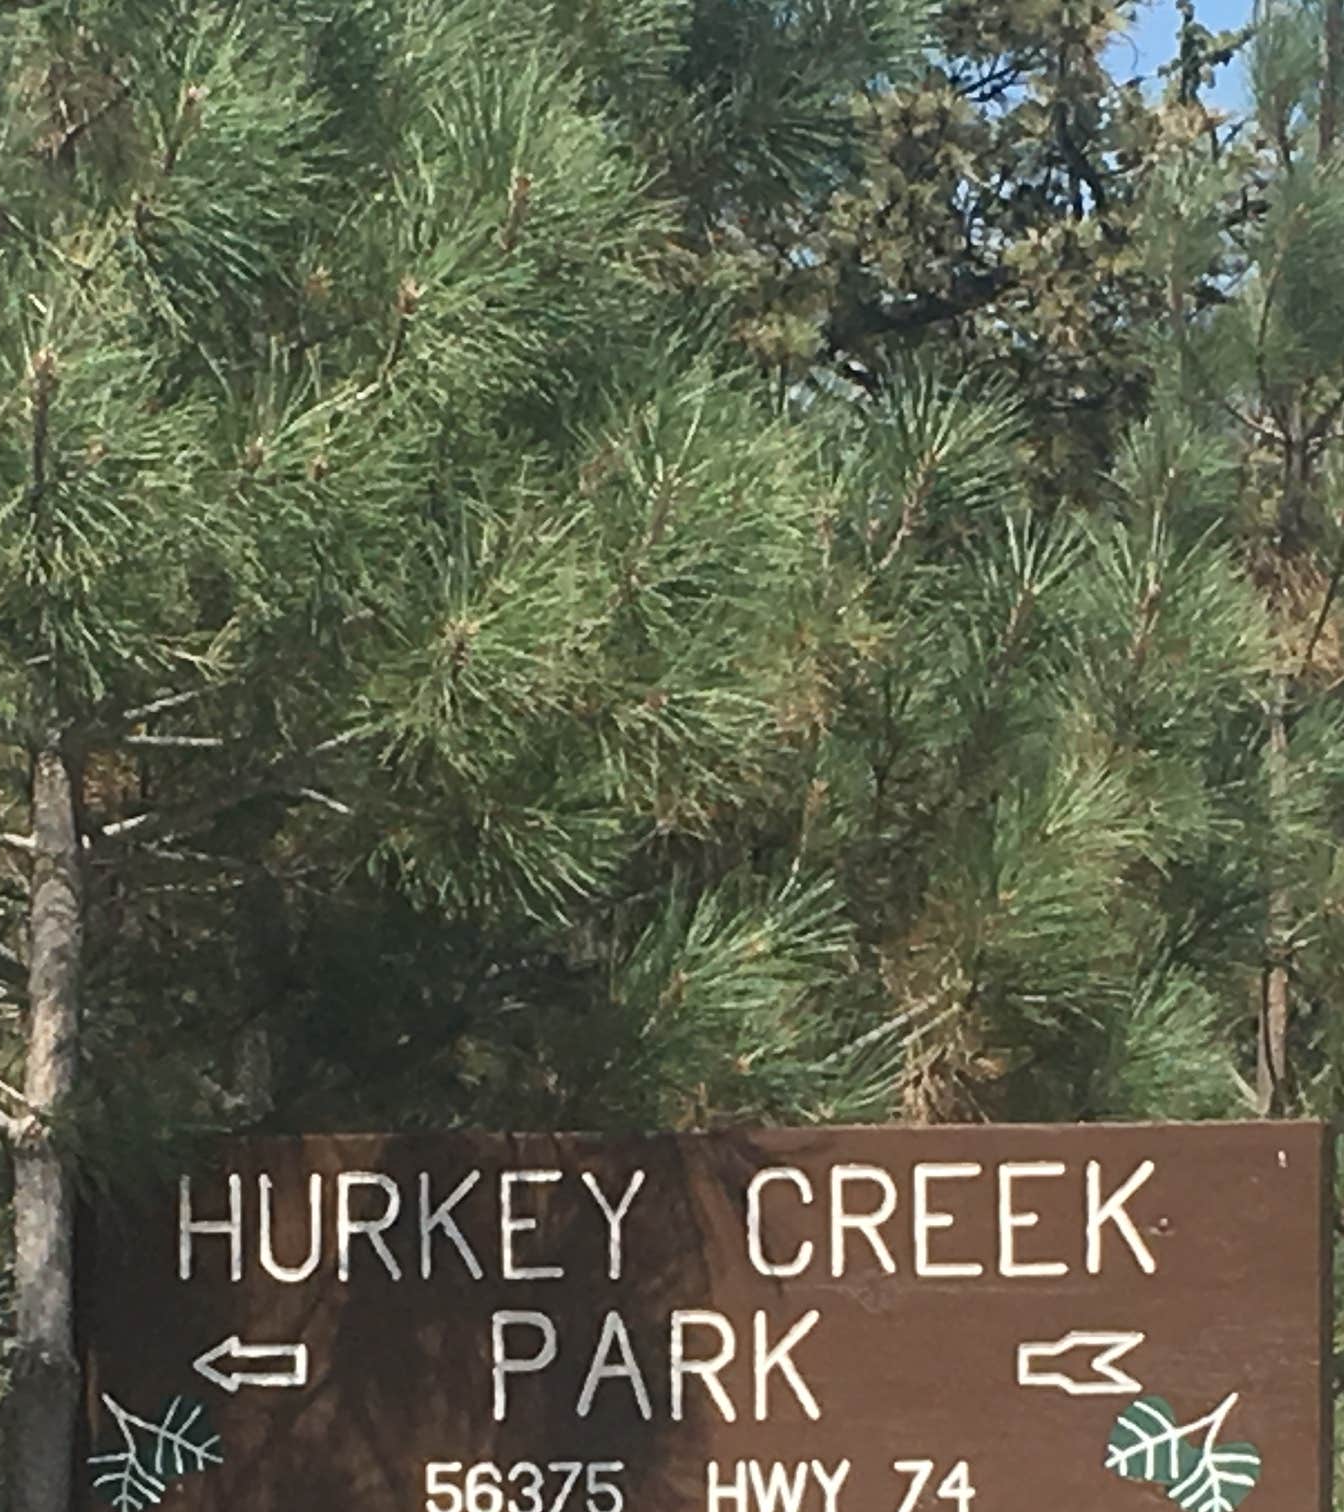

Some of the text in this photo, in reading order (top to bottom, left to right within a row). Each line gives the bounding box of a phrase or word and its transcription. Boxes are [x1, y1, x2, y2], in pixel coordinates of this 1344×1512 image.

[178, 1160, 1157, 1282] HURKEY CREEK
[492, 1310, 821, 1422] PARK
